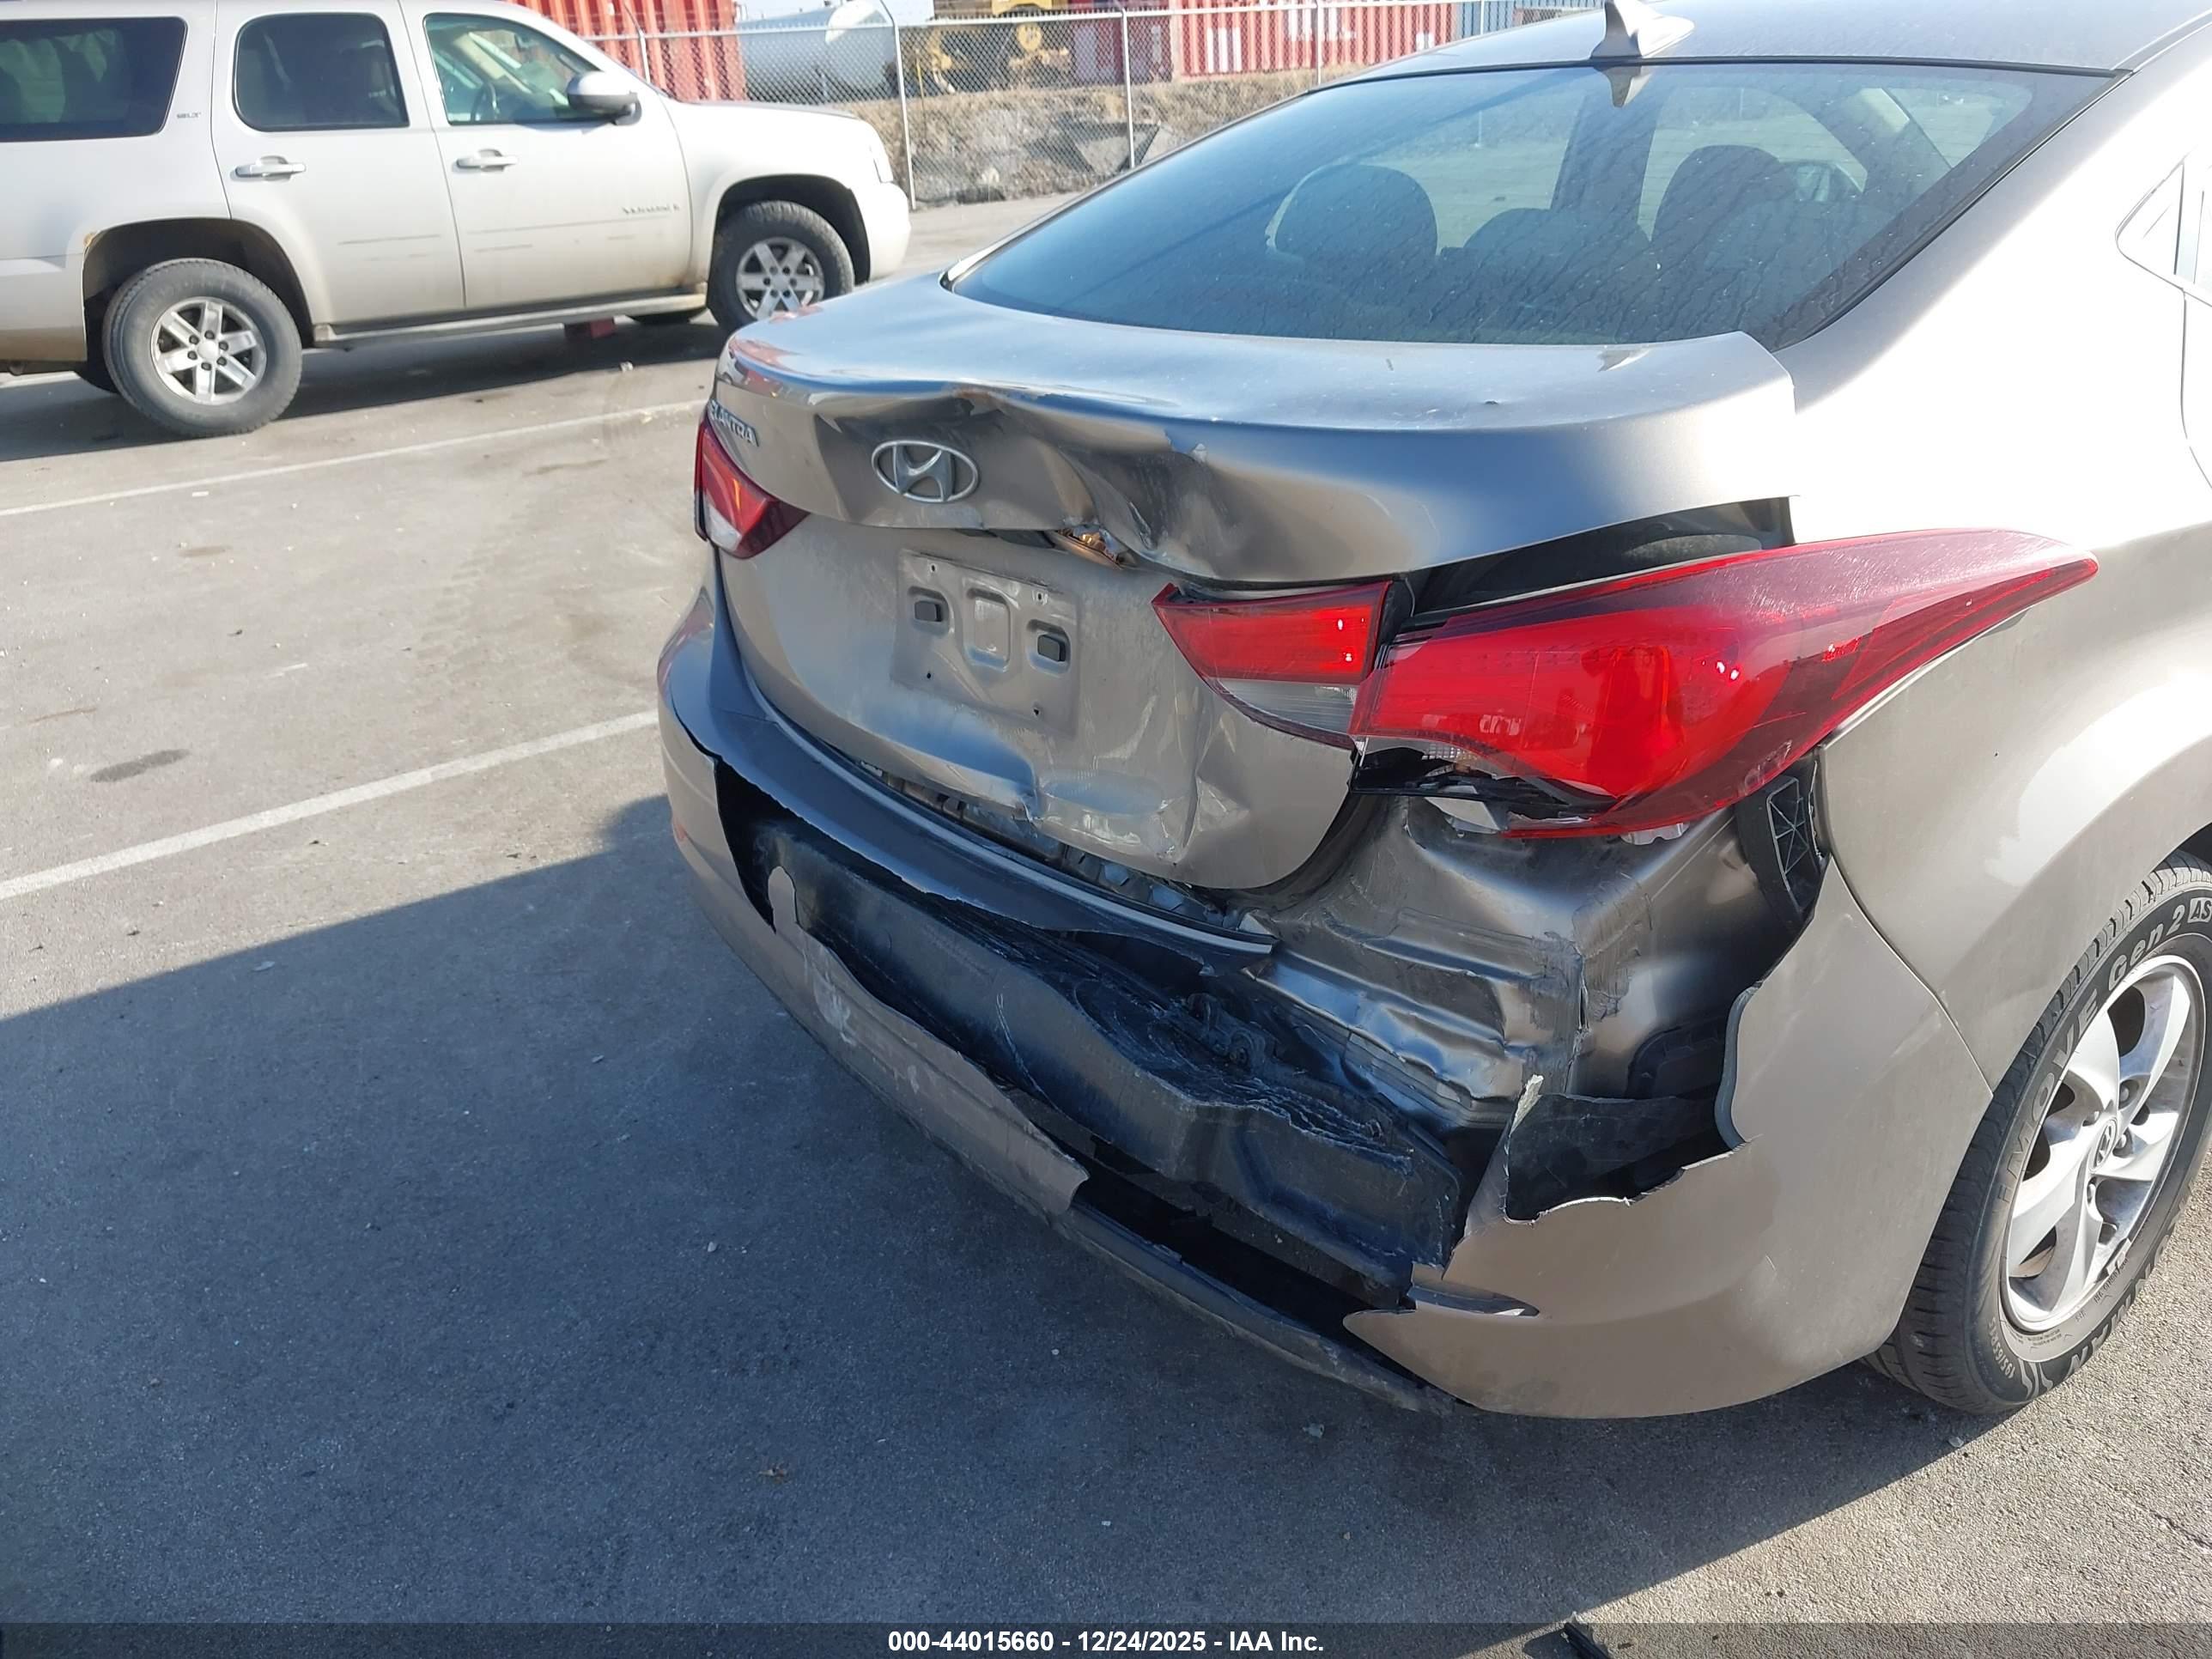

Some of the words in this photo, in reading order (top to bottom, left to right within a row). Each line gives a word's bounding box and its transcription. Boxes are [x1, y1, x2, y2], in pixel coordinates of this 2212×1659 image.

[708, 398, 758, 447] ELANTRA
[2108, 923, 2165, 992] Gen
[2166, 904, 2186, 936] 2
[2190, 899, 2212, 921] AS
